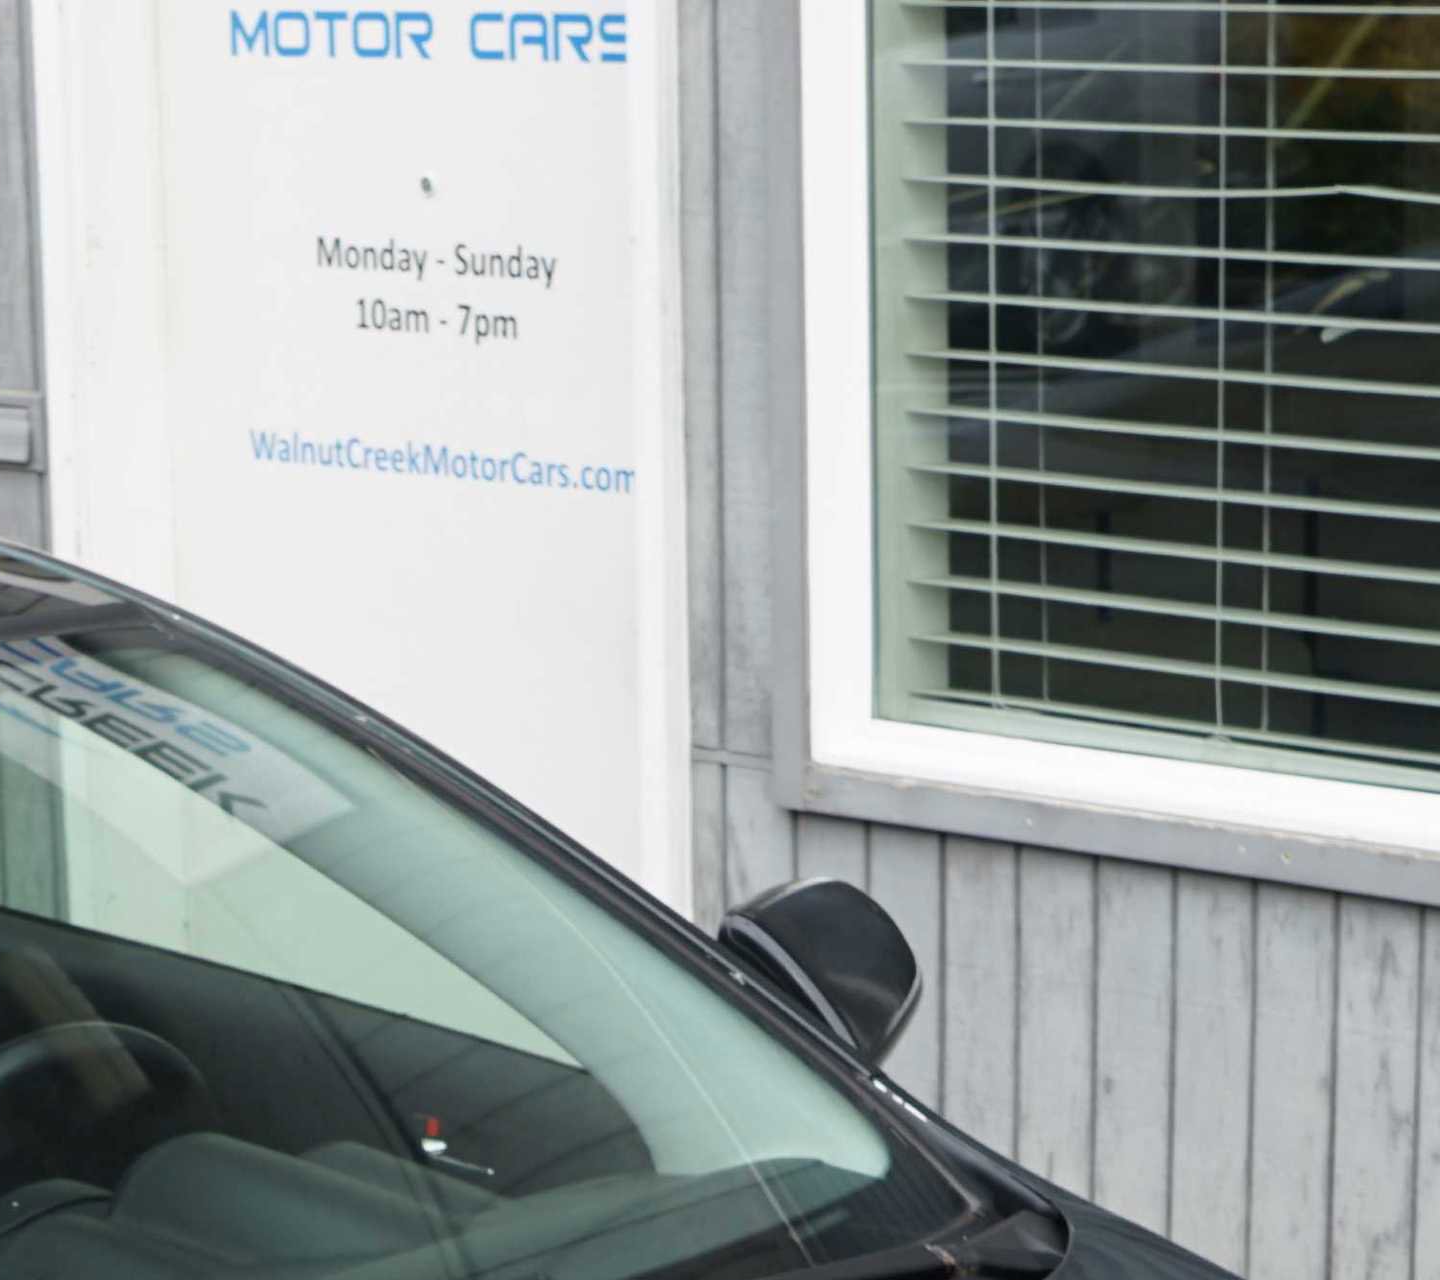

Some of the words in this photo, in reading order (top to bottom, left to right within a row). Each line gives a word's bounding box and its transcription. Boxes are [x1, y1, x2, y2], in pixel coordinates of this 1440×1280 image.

[229, 10, 434, 60] MOTOR
[470, 12, 627, 62] CARS
[316, 236, 428, 280] Monday
[454, 243, 558, 289] Sunday
[356, 298, 430, 334] 10am
[458, 304, 519, 346] 7pm
[250, 429, 636, 496] WalnutCreekMotorCars.com
